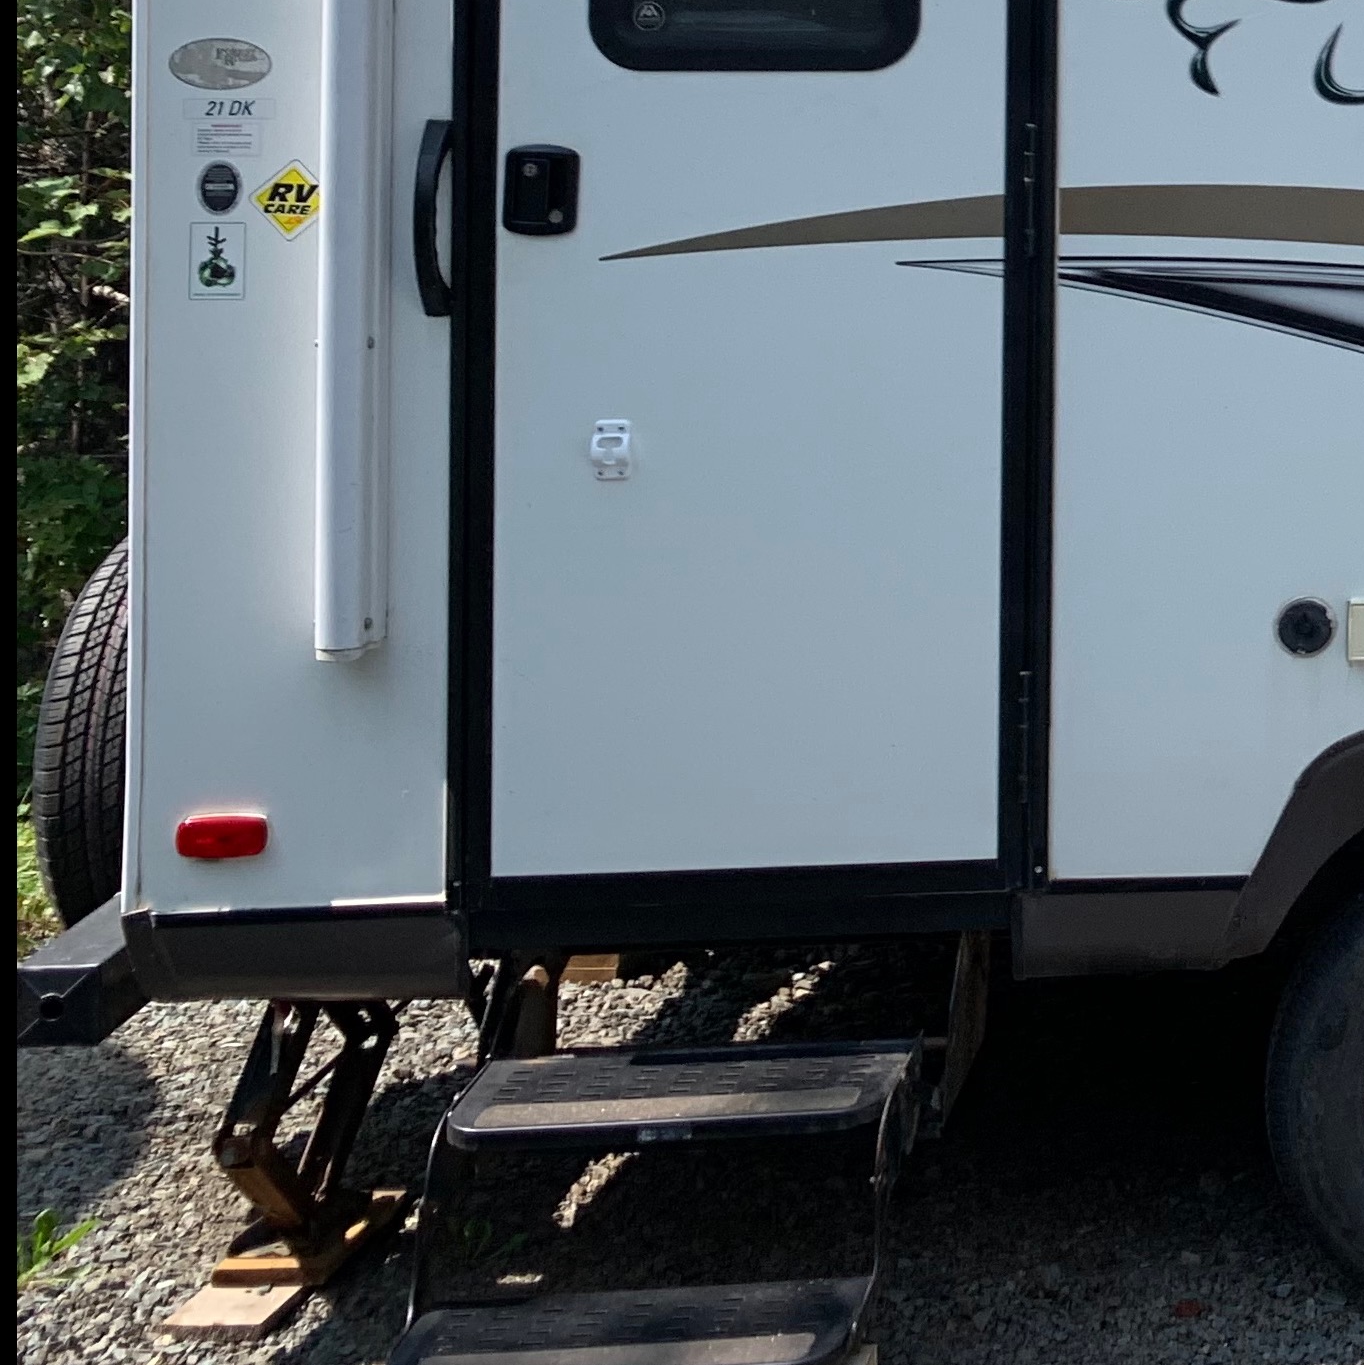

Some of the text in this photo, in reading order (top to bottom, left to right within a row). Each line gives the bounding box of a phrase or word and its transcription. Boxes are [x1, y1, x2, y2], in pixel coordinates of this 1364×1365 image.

[205, 100, 256, 116] 21 DK
[267, 183, 319, 203] RV
[263, 203, 311, 215] CARE
